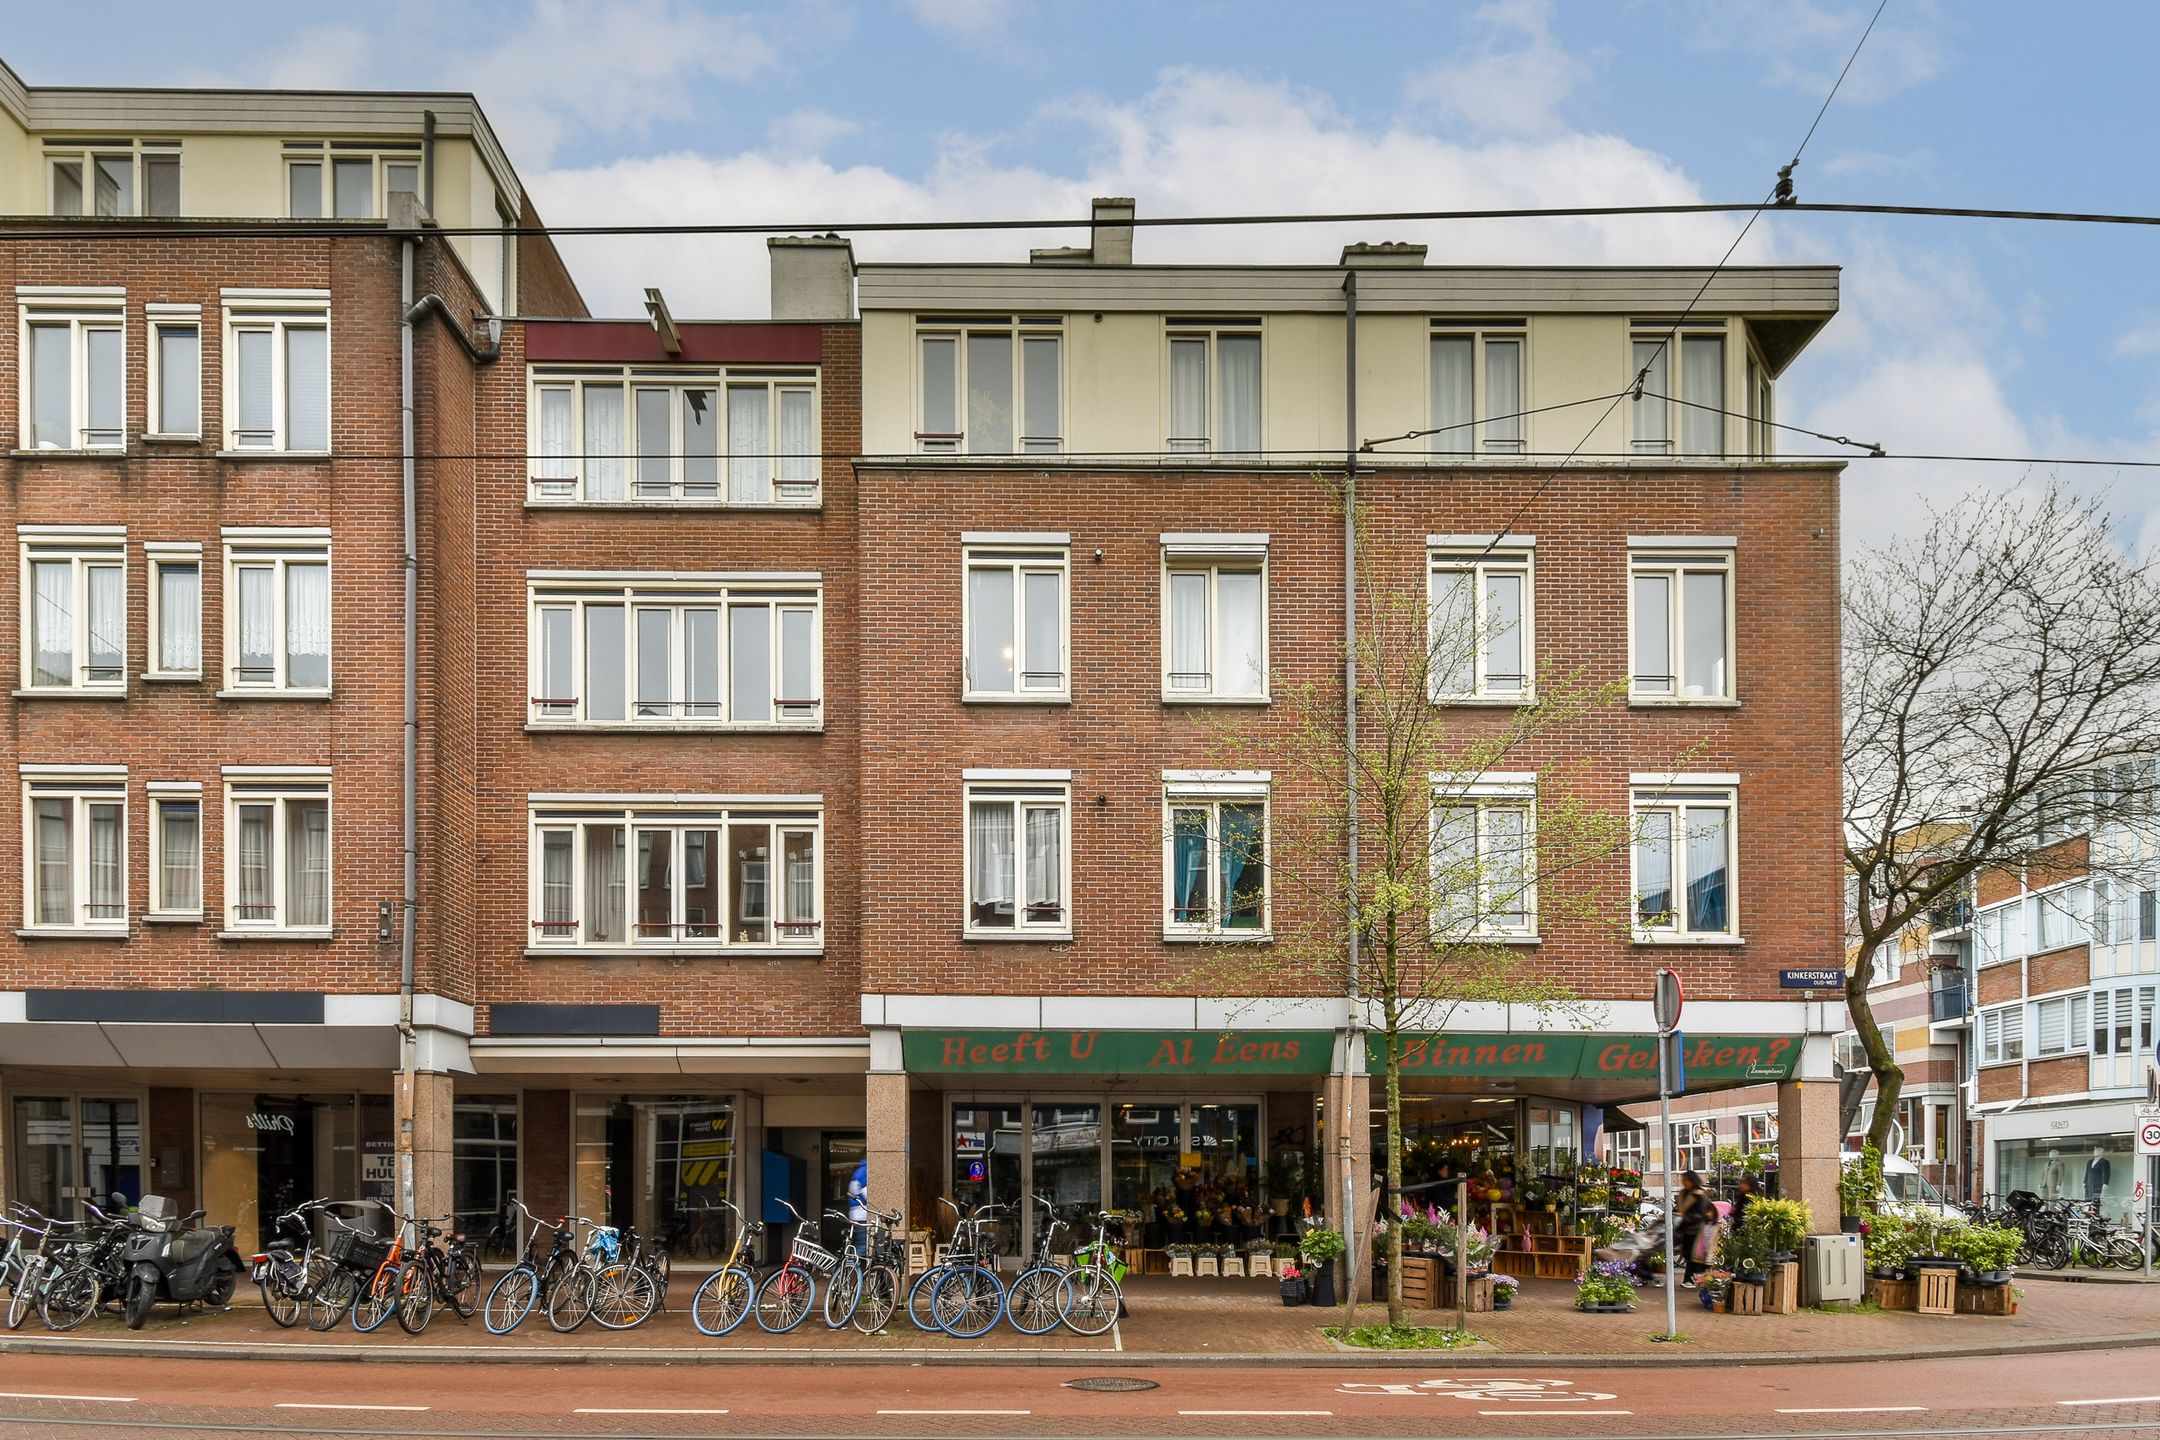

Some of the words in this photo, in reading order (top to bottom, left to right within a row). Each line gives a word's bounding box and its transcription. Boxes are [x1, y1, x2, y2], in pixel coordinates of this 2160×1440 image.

[1787, 971, 1838, 980] KINKERSTRAAT
[941, 1032, 1051, 1067] Heeft
[1070, 1031, 1098, 1059] U
[1147, 1038, 1195, 1067] Al
[1212, 1035, 1300, 1065] Eens
[1399, 1039, 1546, 1068] Binnen
[2051, 1120, 2070, 1128] GENTS
[2146, 1130, 2160, 1140] 30
[377, 1156, 395, 1167] TE
